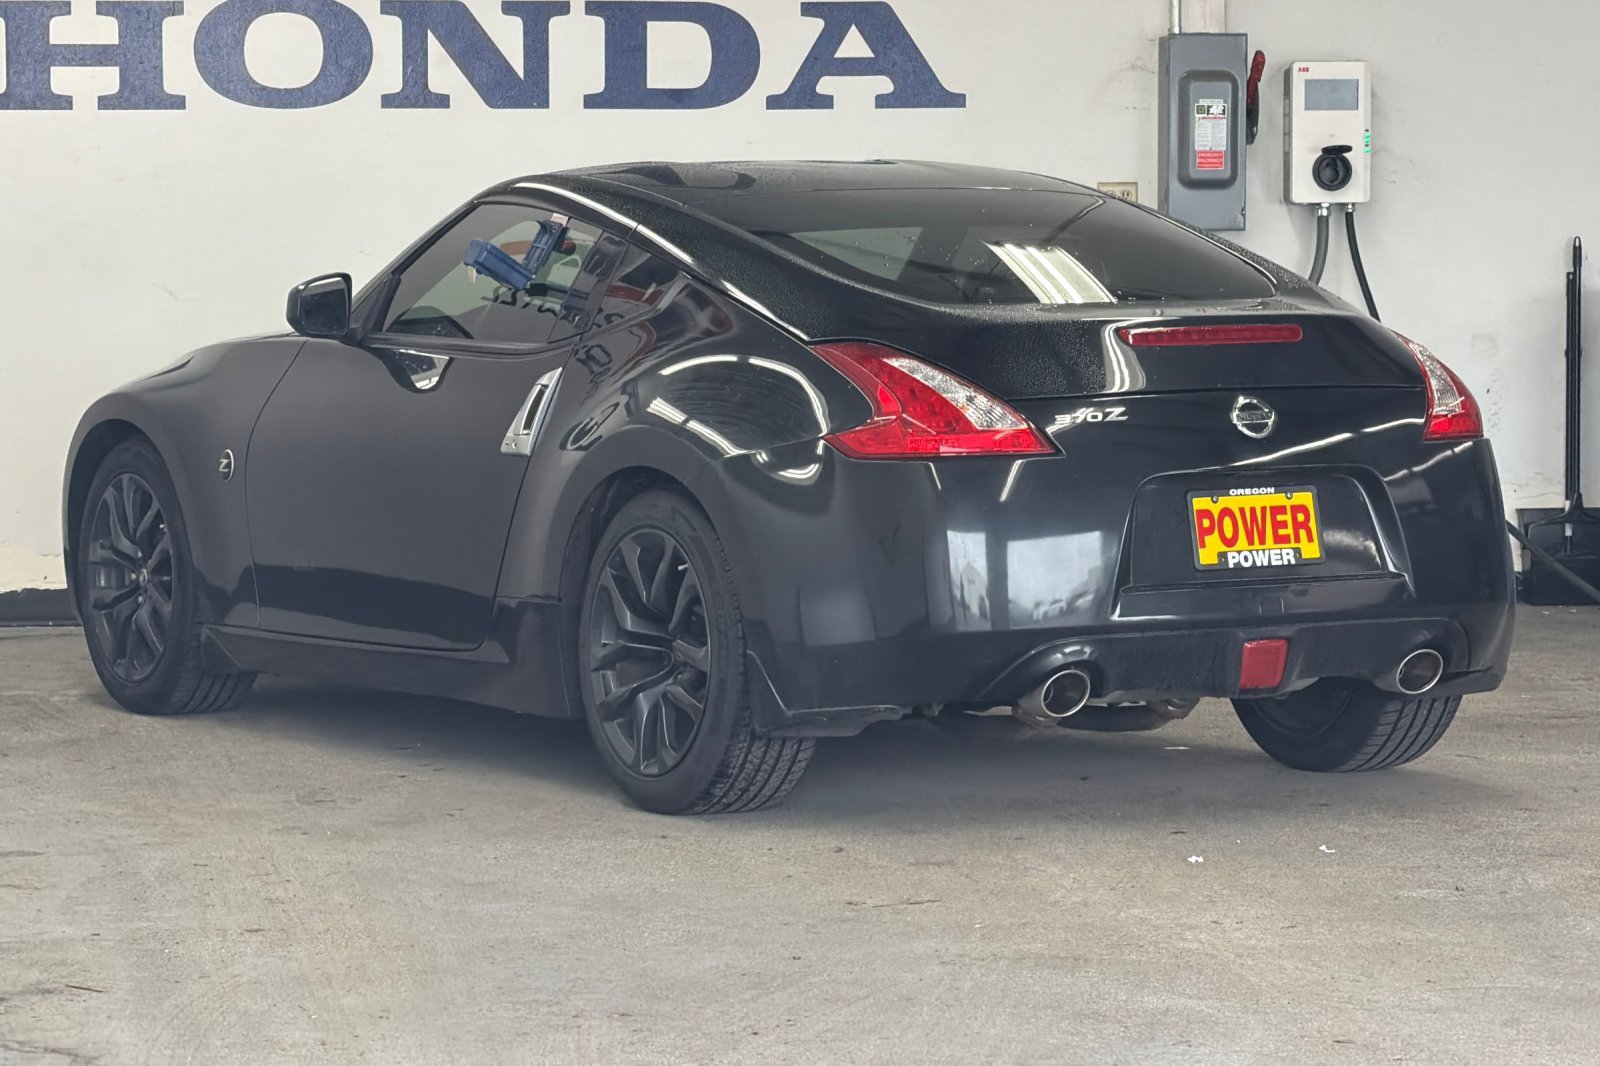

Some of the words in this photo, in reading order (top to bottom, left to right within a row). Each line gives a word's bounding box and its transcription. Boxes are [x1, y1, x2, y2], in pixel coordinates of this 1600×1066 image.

[0, 0, 966, 110] HONDA
[1055, 407, 1128, 424] 370Z
[1229, 487, 1275, 496] OREGON
[1195, 504, 1315, 549] POWER
[1227, 548, 1296, 569] POWER
